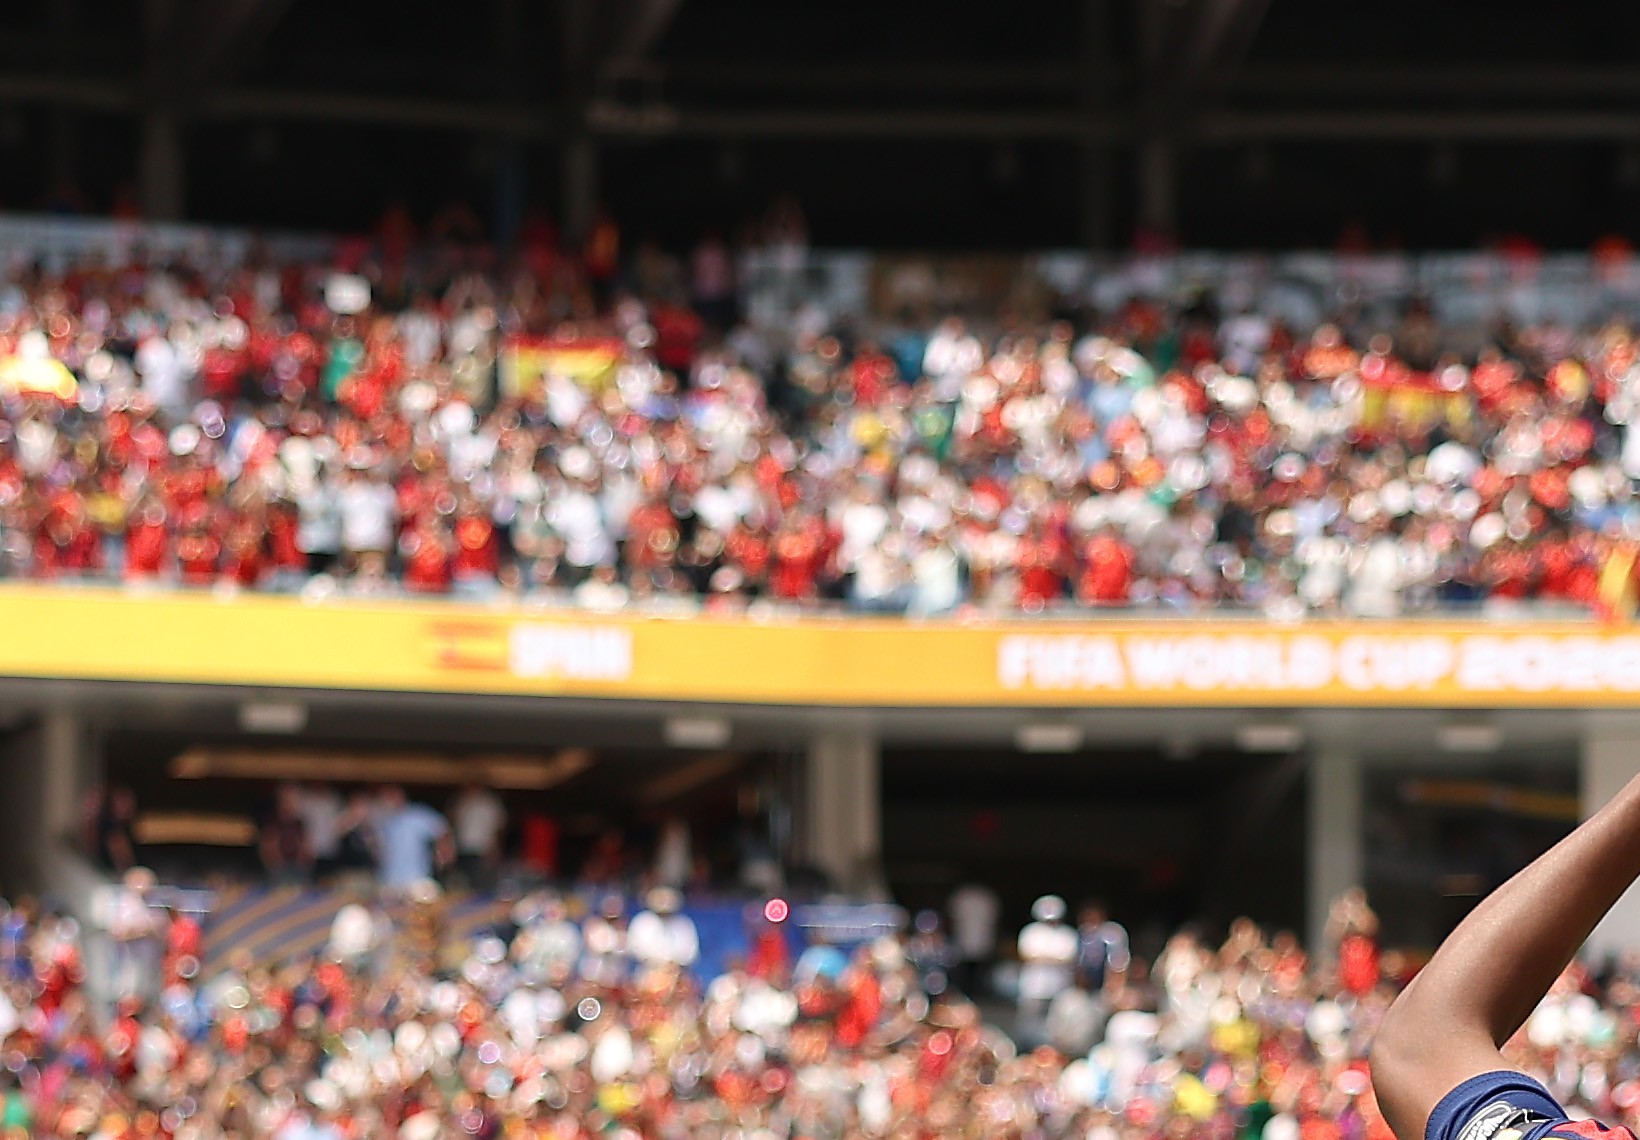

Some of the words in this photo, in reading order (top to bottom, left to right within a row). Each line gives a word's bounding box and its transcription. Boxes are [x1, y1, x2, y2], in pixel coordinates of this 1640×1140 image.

[998, 634, 1127, 691] FIFA
[1127, 634, 1334, 691] WORLD
[1339, 635, 1450, 691] CUP
